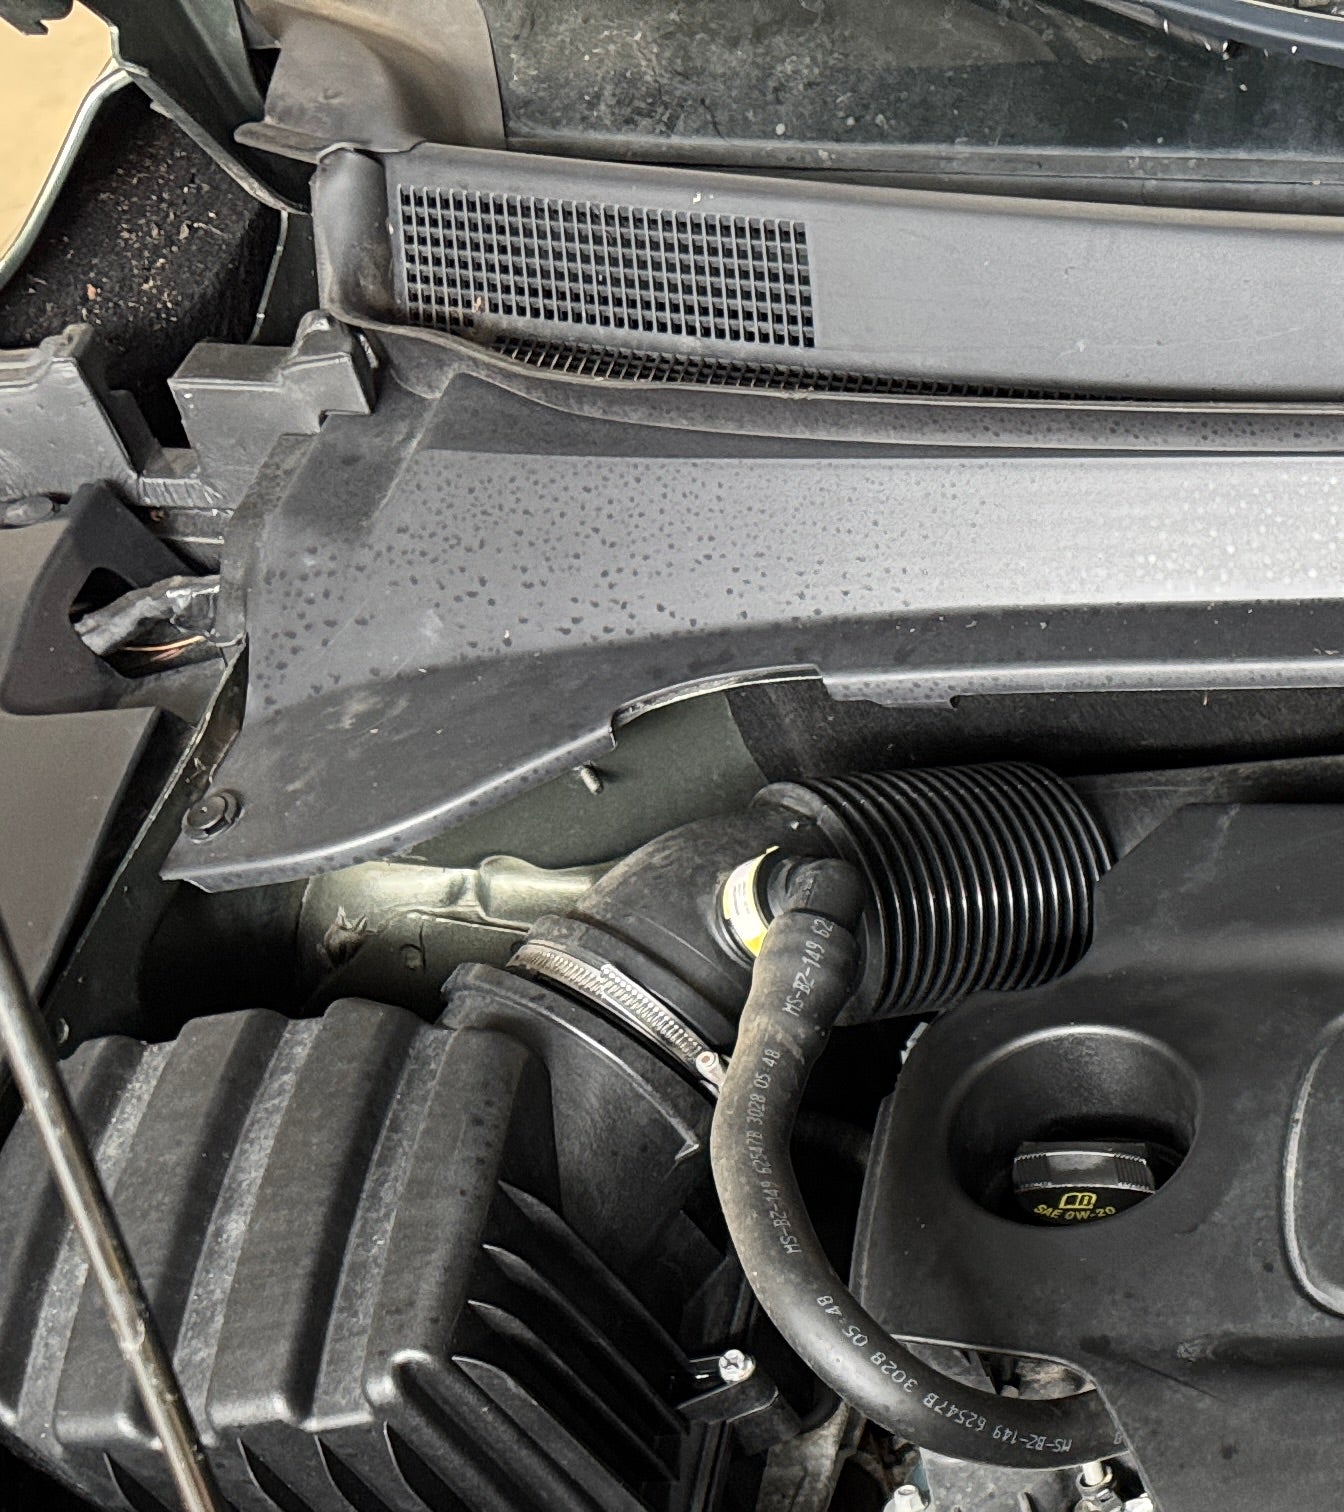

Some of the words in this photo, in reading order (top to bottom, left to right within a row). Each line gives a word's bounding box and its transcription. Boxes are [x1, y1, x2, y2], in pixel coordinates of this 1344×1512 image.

[1033, 1203, 1062, 1219] SAE
[1064, 1204, 1116, 1221] 0W-20
[868, 1350, 920, 1394] 3028
[921, 1391, 988, 1433] 62547B
[992, 1424, 1073, 1454] MS-BZ-149
